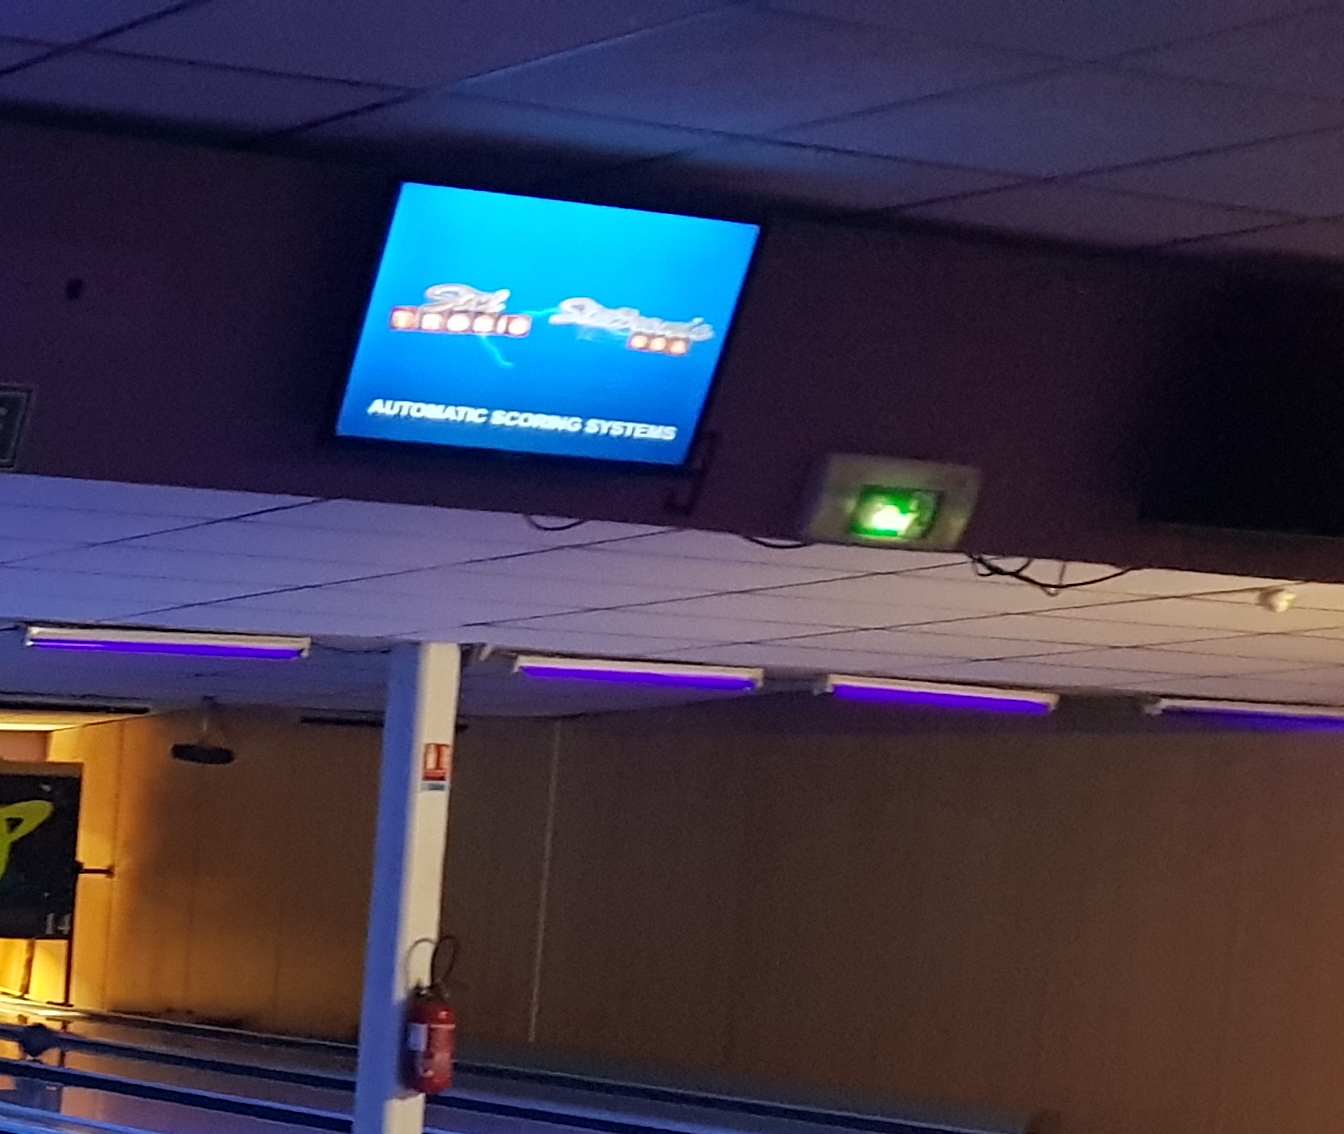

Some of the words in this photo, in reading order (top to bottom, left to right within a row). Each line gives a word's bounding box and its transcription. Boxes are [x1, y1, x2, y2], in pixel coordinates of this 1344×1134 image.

[367, 398, 489, 424] AUTOMATIC
[491, 409, 583, 433] SCORING
[585, 418, 678, 441] SYSTEMS
[44, 912, 71, 936] 14
